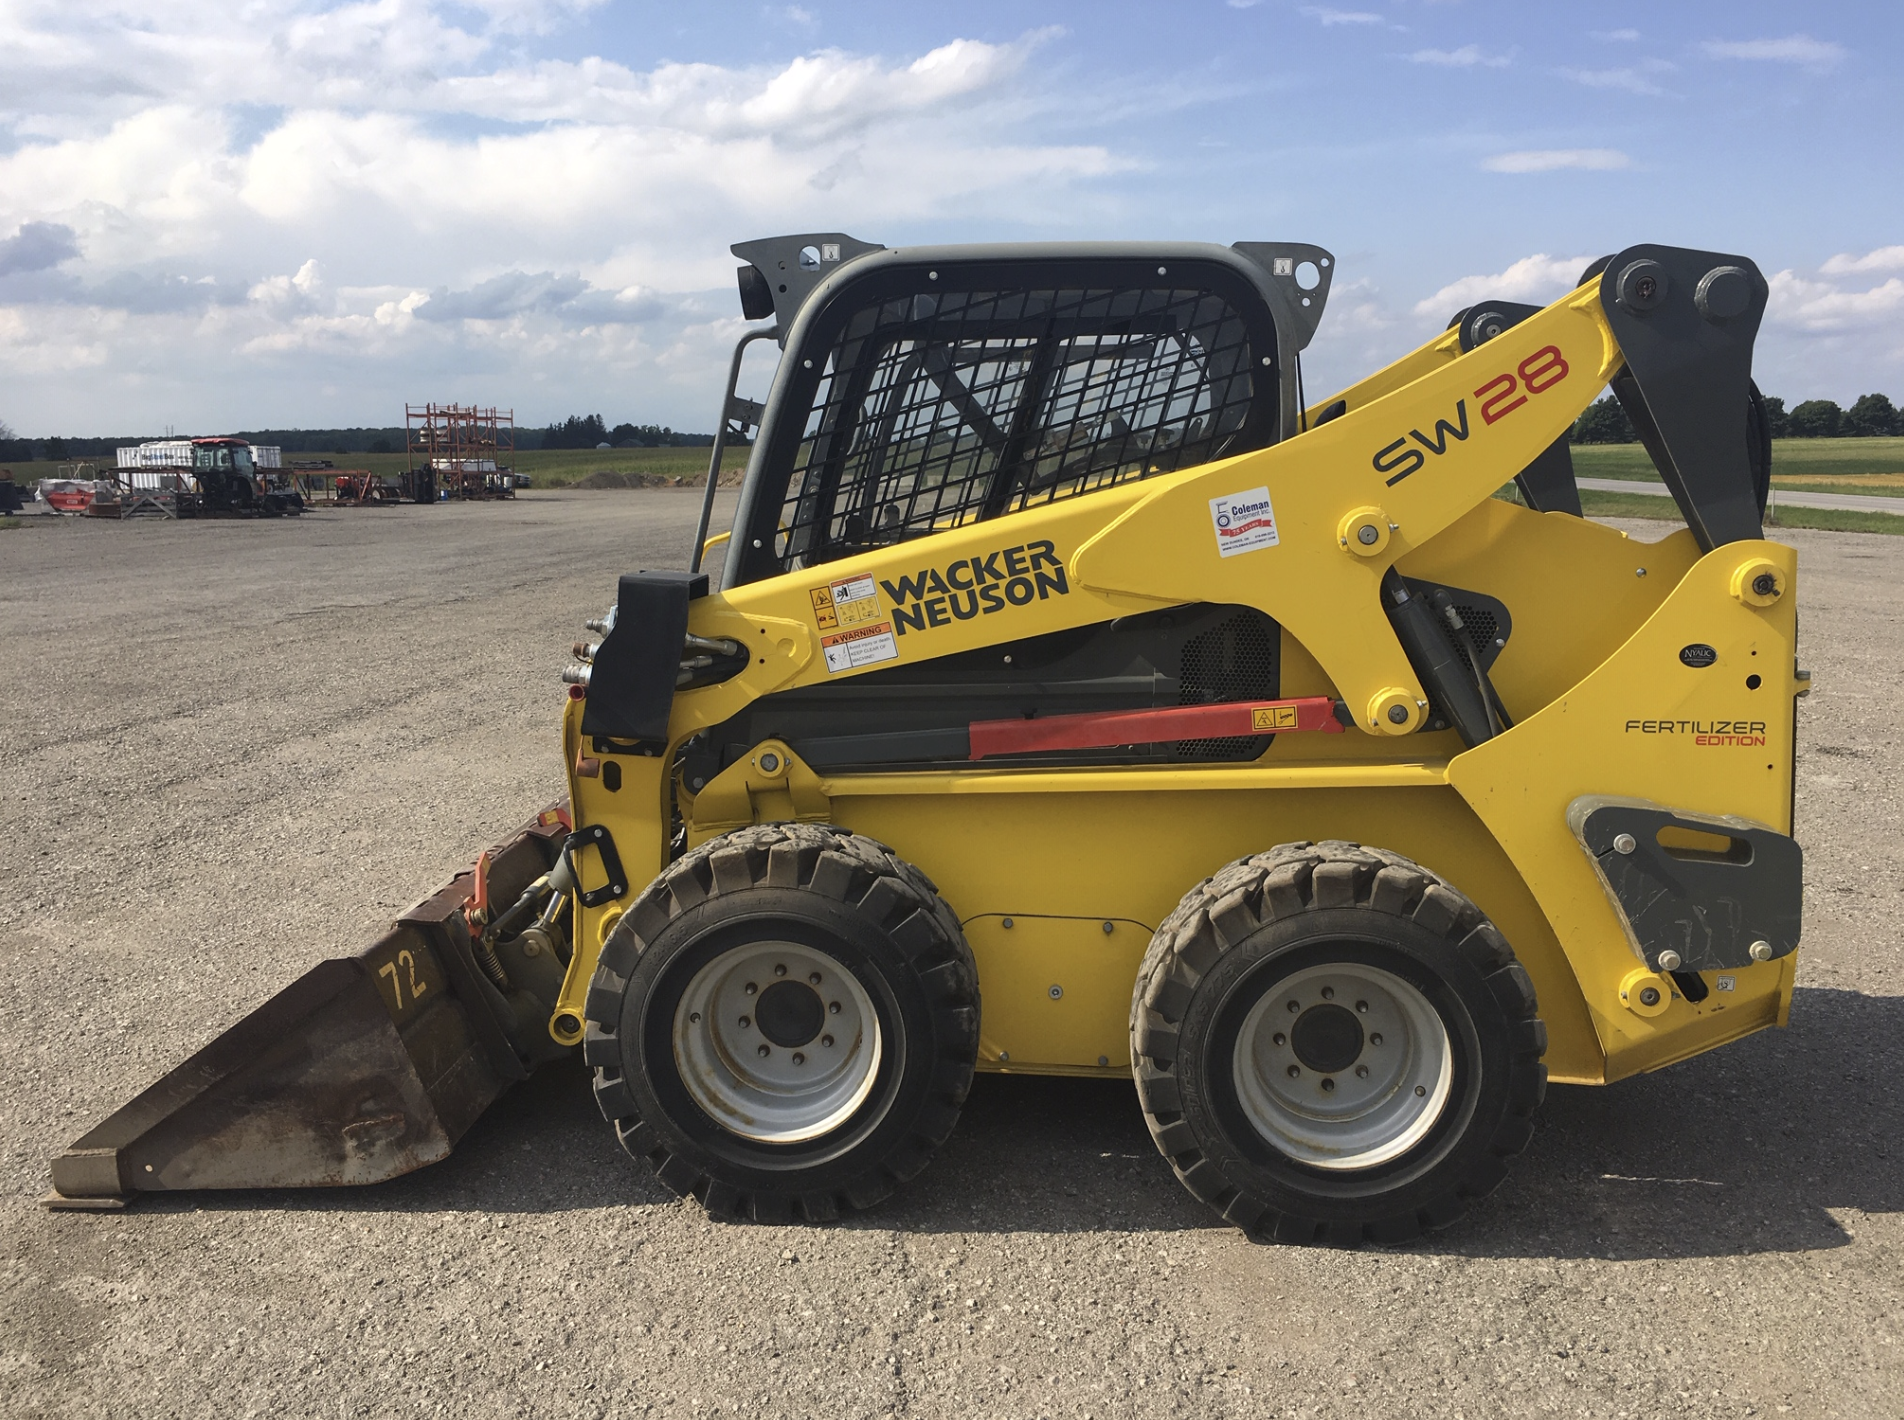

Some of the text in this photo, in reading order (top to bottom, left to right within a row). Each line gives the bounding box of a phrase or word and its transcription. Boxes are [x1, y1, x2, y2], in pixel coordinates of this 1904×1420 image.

[1372, 345, 1569, 487] SW28
[1231, 501, 1270, 516] Coleman
[1232, 510, 1261, 522] Equipment
[879, 539, 1063, 606] WACKER
[891, 565, 1070, 636] NEUSON
[839, 626, 882, 642] WARNING
[862, 641, 873, 649] injury
[1625, 720, 1766, 735] FERTILIZER
[1695, 735, 1766, 746] EDITION
[378, 949, 427, 1010] 72
